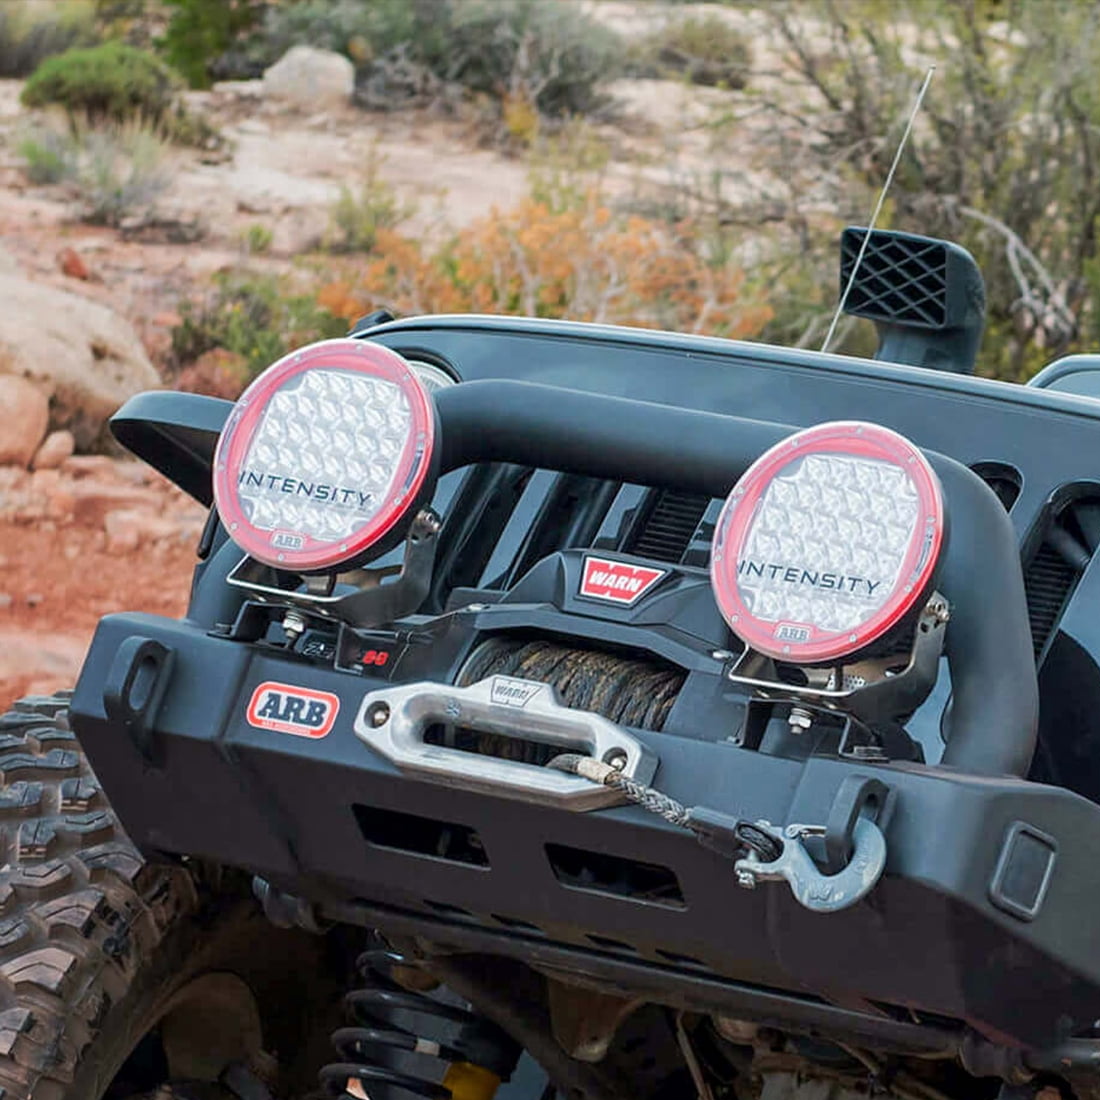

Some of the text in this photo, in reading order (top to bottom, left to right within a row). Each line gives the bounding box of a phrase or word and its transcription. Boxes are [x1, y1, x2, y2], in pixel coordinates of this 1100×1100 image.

[239, 471, 371, 506] INTENSITY
[588, 569, 643, 592] WARN
[738, 560, 881, 595] INTENSITY
[257, 692, 327, 727] ARB
